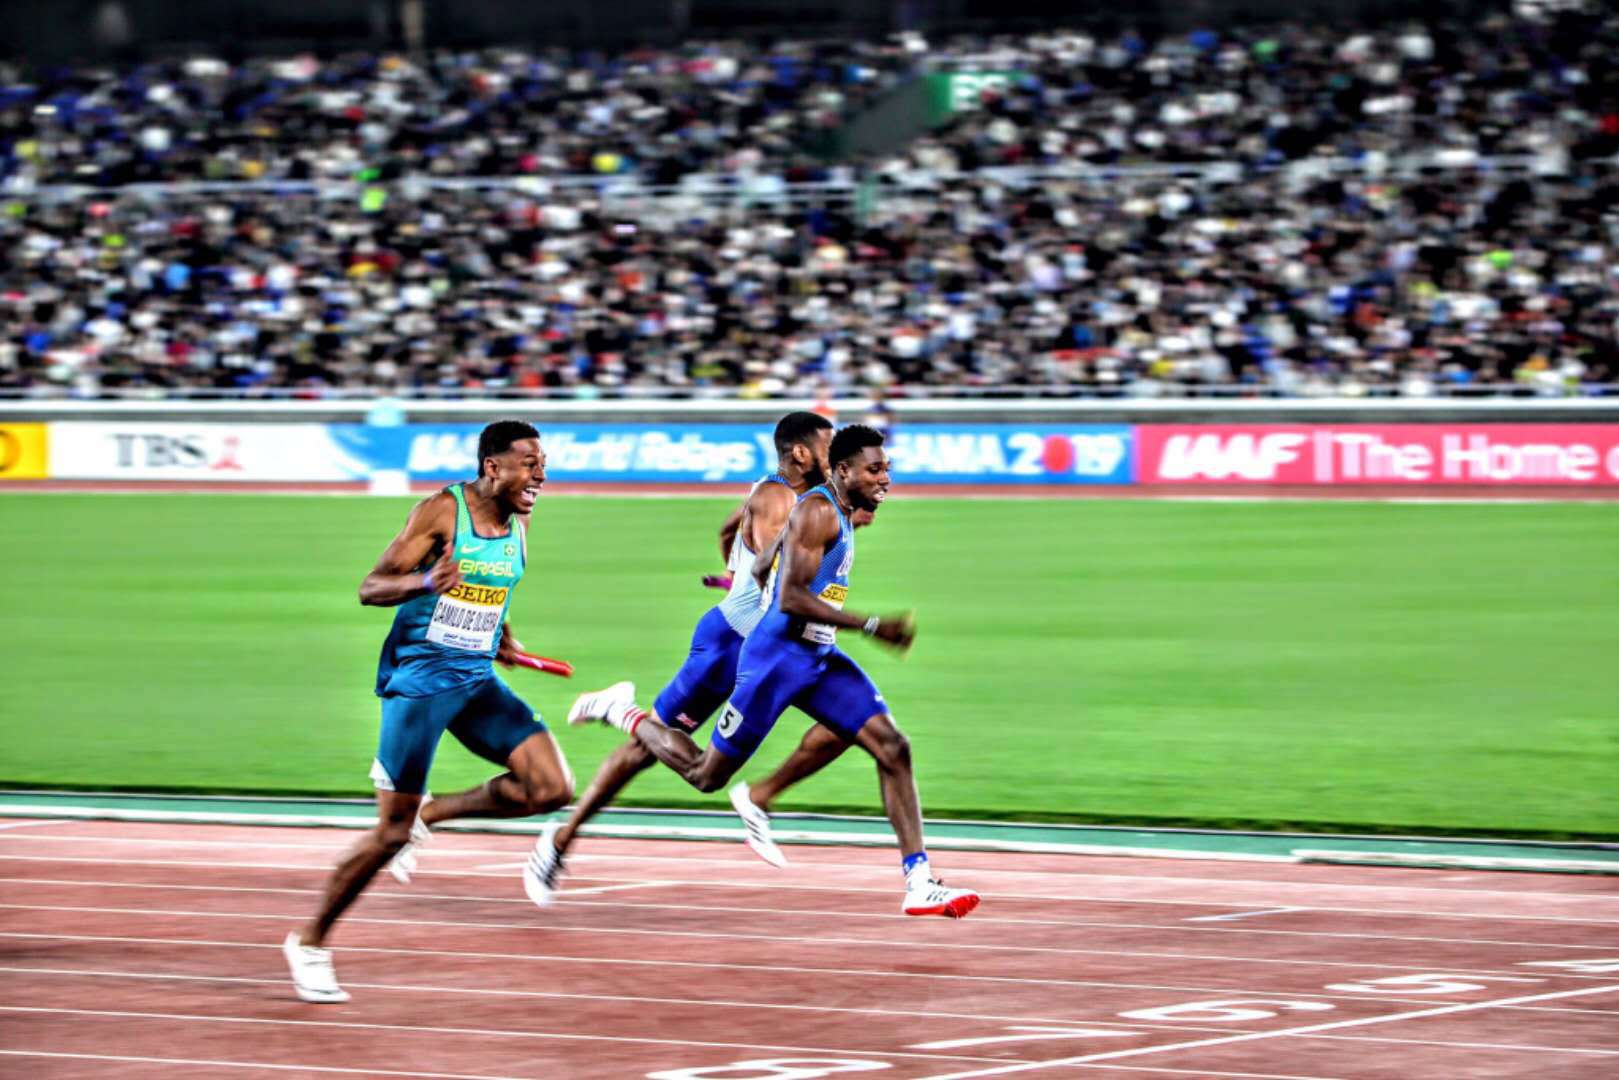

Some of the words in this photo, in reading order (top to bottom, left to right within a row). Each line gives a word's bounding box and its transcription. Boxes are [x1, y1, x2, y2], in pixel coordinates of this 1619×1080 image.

[107, 433, 208, 468] TBS
[632, 431, 756, 481] Relays
[1008, 432, 1125, 475] 2019
[1158, 433, 1307, 479] IAAF
[1331, 433, 1433, 480] The
[1442, 434, 1599, 480] Home
[459, 559, 514, 577] BRASIL
[448, 584, 507, 605] SEIKO
[719, 710, 735, 730] 5
